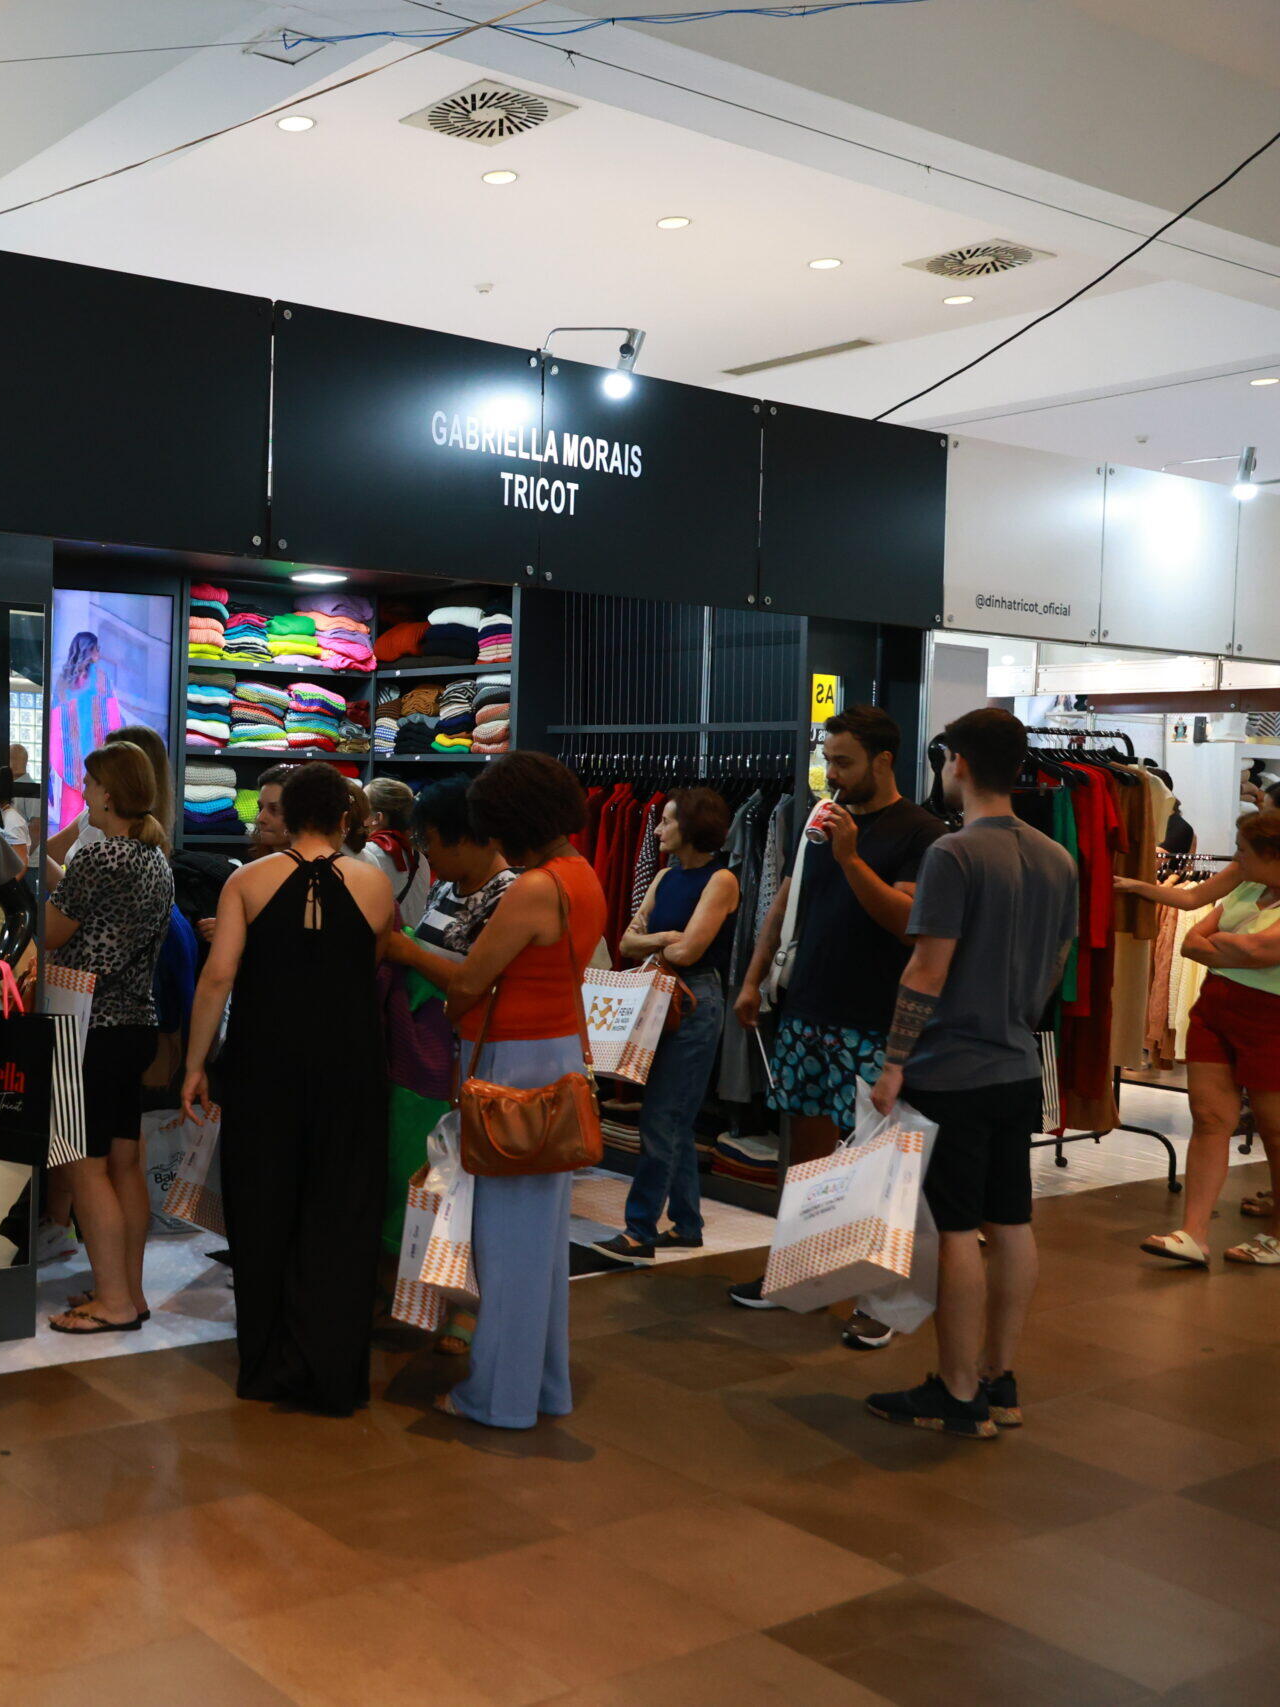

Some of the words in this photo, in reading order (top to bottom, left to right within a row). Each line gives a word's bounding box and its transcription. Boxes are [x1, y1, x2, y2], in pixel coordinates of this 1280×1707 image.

[431, 410, 558, 465] GABRIELLA
[562, 432, 643, 478] MORAIS
[500, 471, 579, 516] TRICOT
[975, 593, 1071, 616] @dinhatricot_oficial
